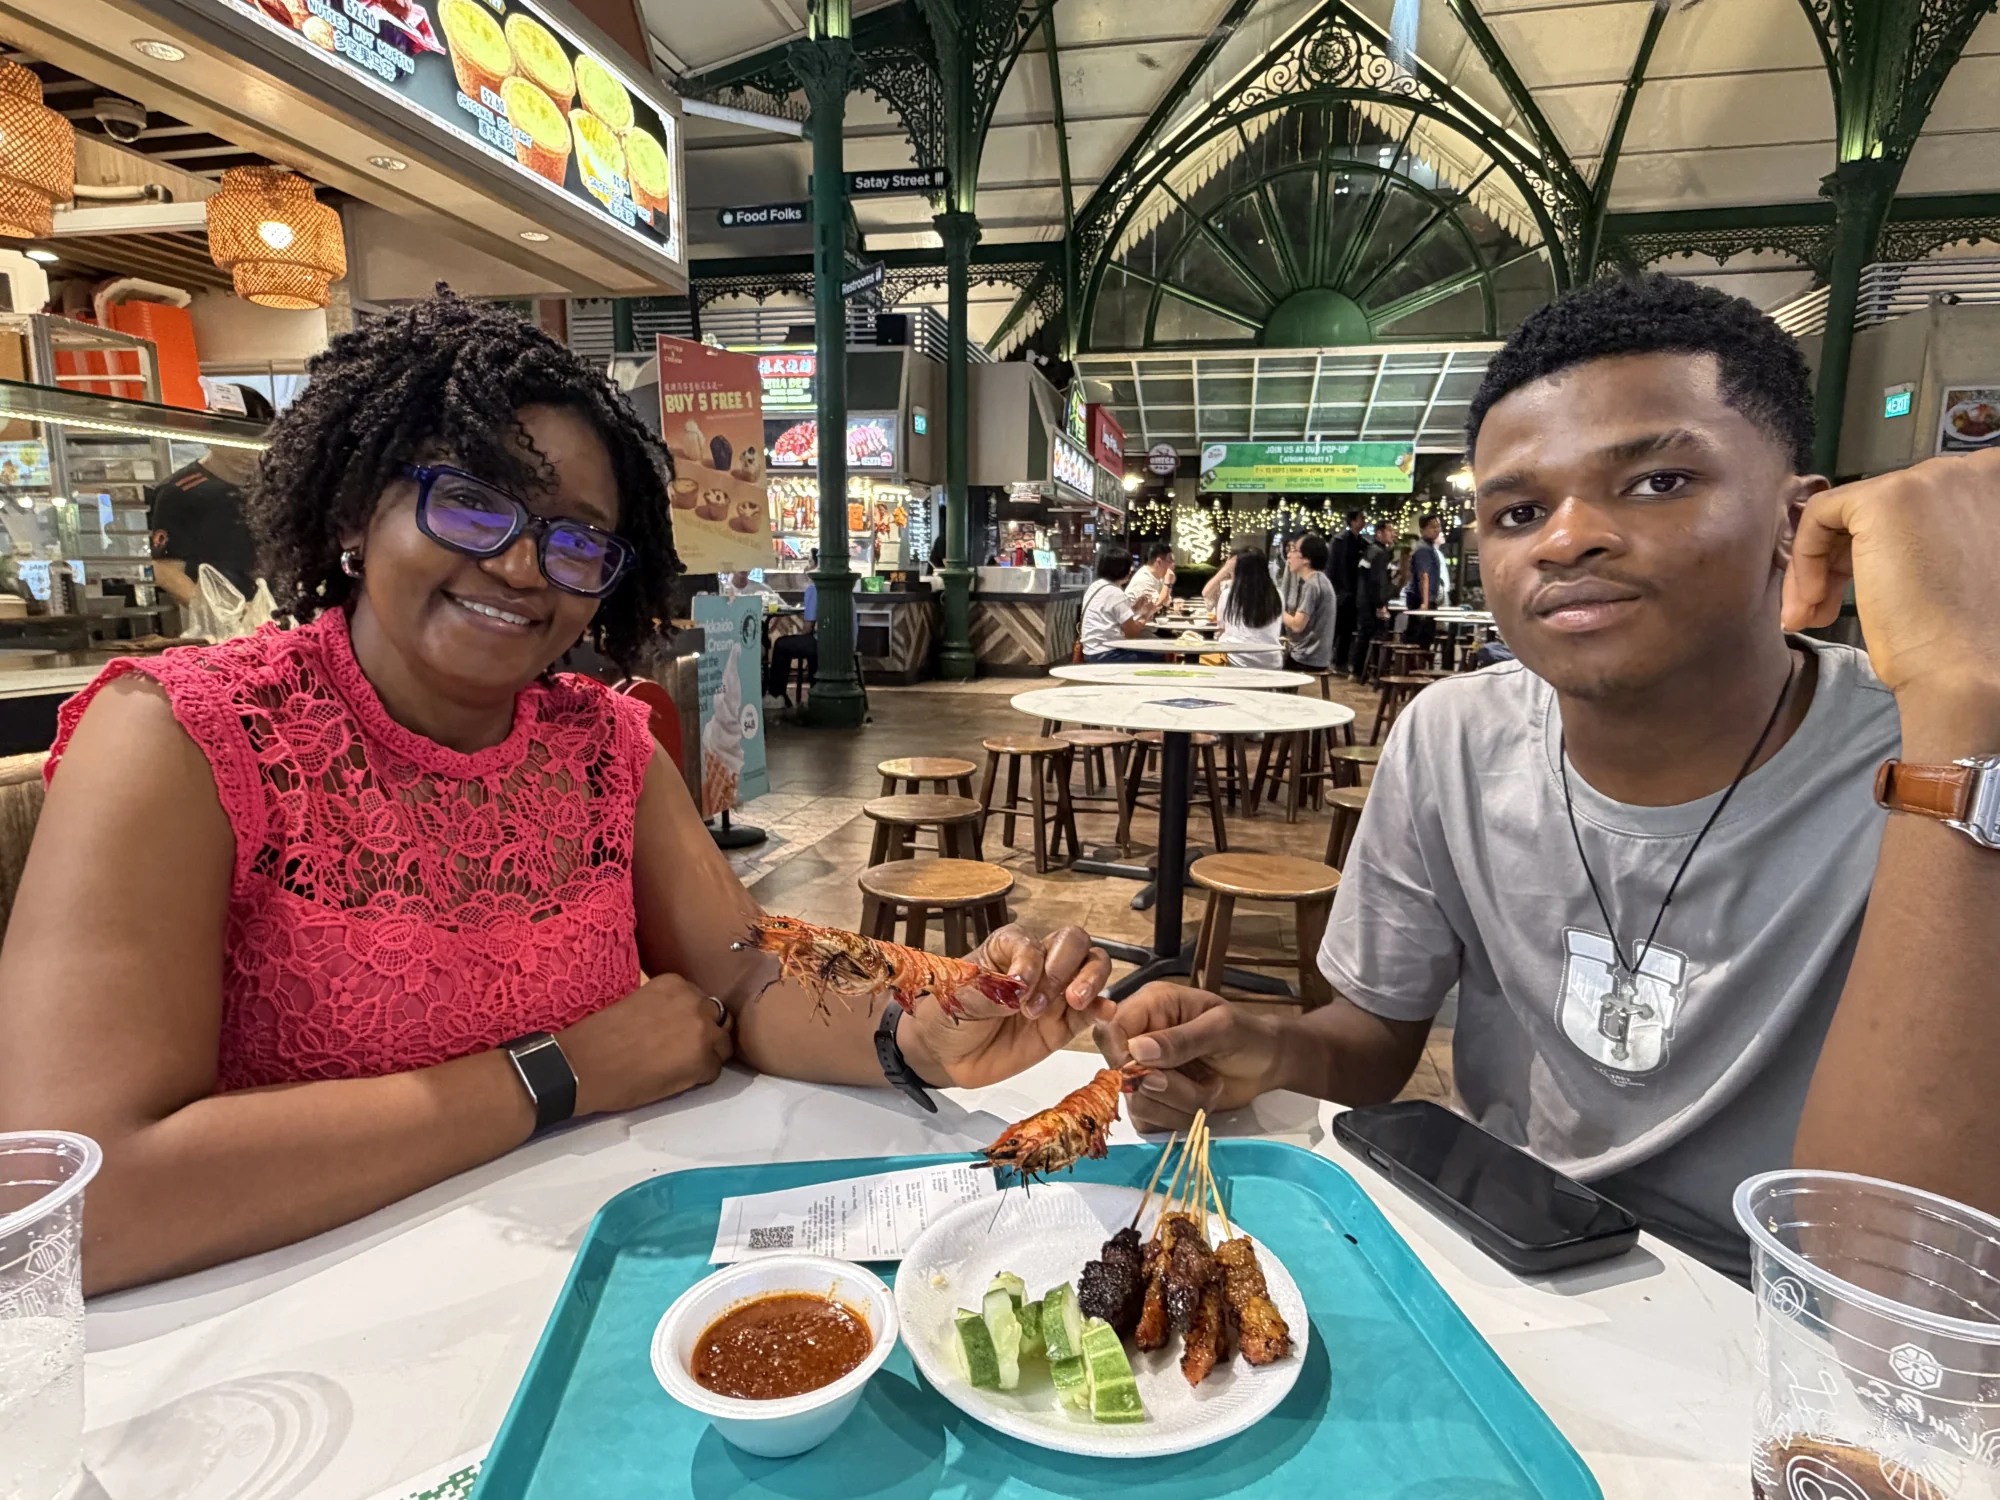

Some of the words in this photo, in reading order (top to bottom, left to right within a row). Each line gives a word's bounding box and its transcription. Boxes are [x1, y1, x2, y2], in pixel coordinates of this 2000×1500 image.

[353, 25, 374, 47] NUT
[377, 41, 414, 72] MUFFIN
[855, 175, 890, 190] Satay
[892, 173, 930, 187] Street
[736, 209, 767, 223] Food
[770, 207, 802, 222] Folks
[842, 273, 875, 296] Restrooms
[665, 394, 694, 413] BUY
[698, 392, 708, 411] 5
[710, 391, 743, 410] FREE
[745, 391, 753, 408] 1
[1891, 397, 1908, 413] EXIT
[1265, 445, 1282, 453] JOIN
[1283, 445, 1294, 453] US
[1295, 445, 1304, 453] AT
[1322, 446, 1349, 454] POP-UP
[708, 640, 734, 652] Cream
